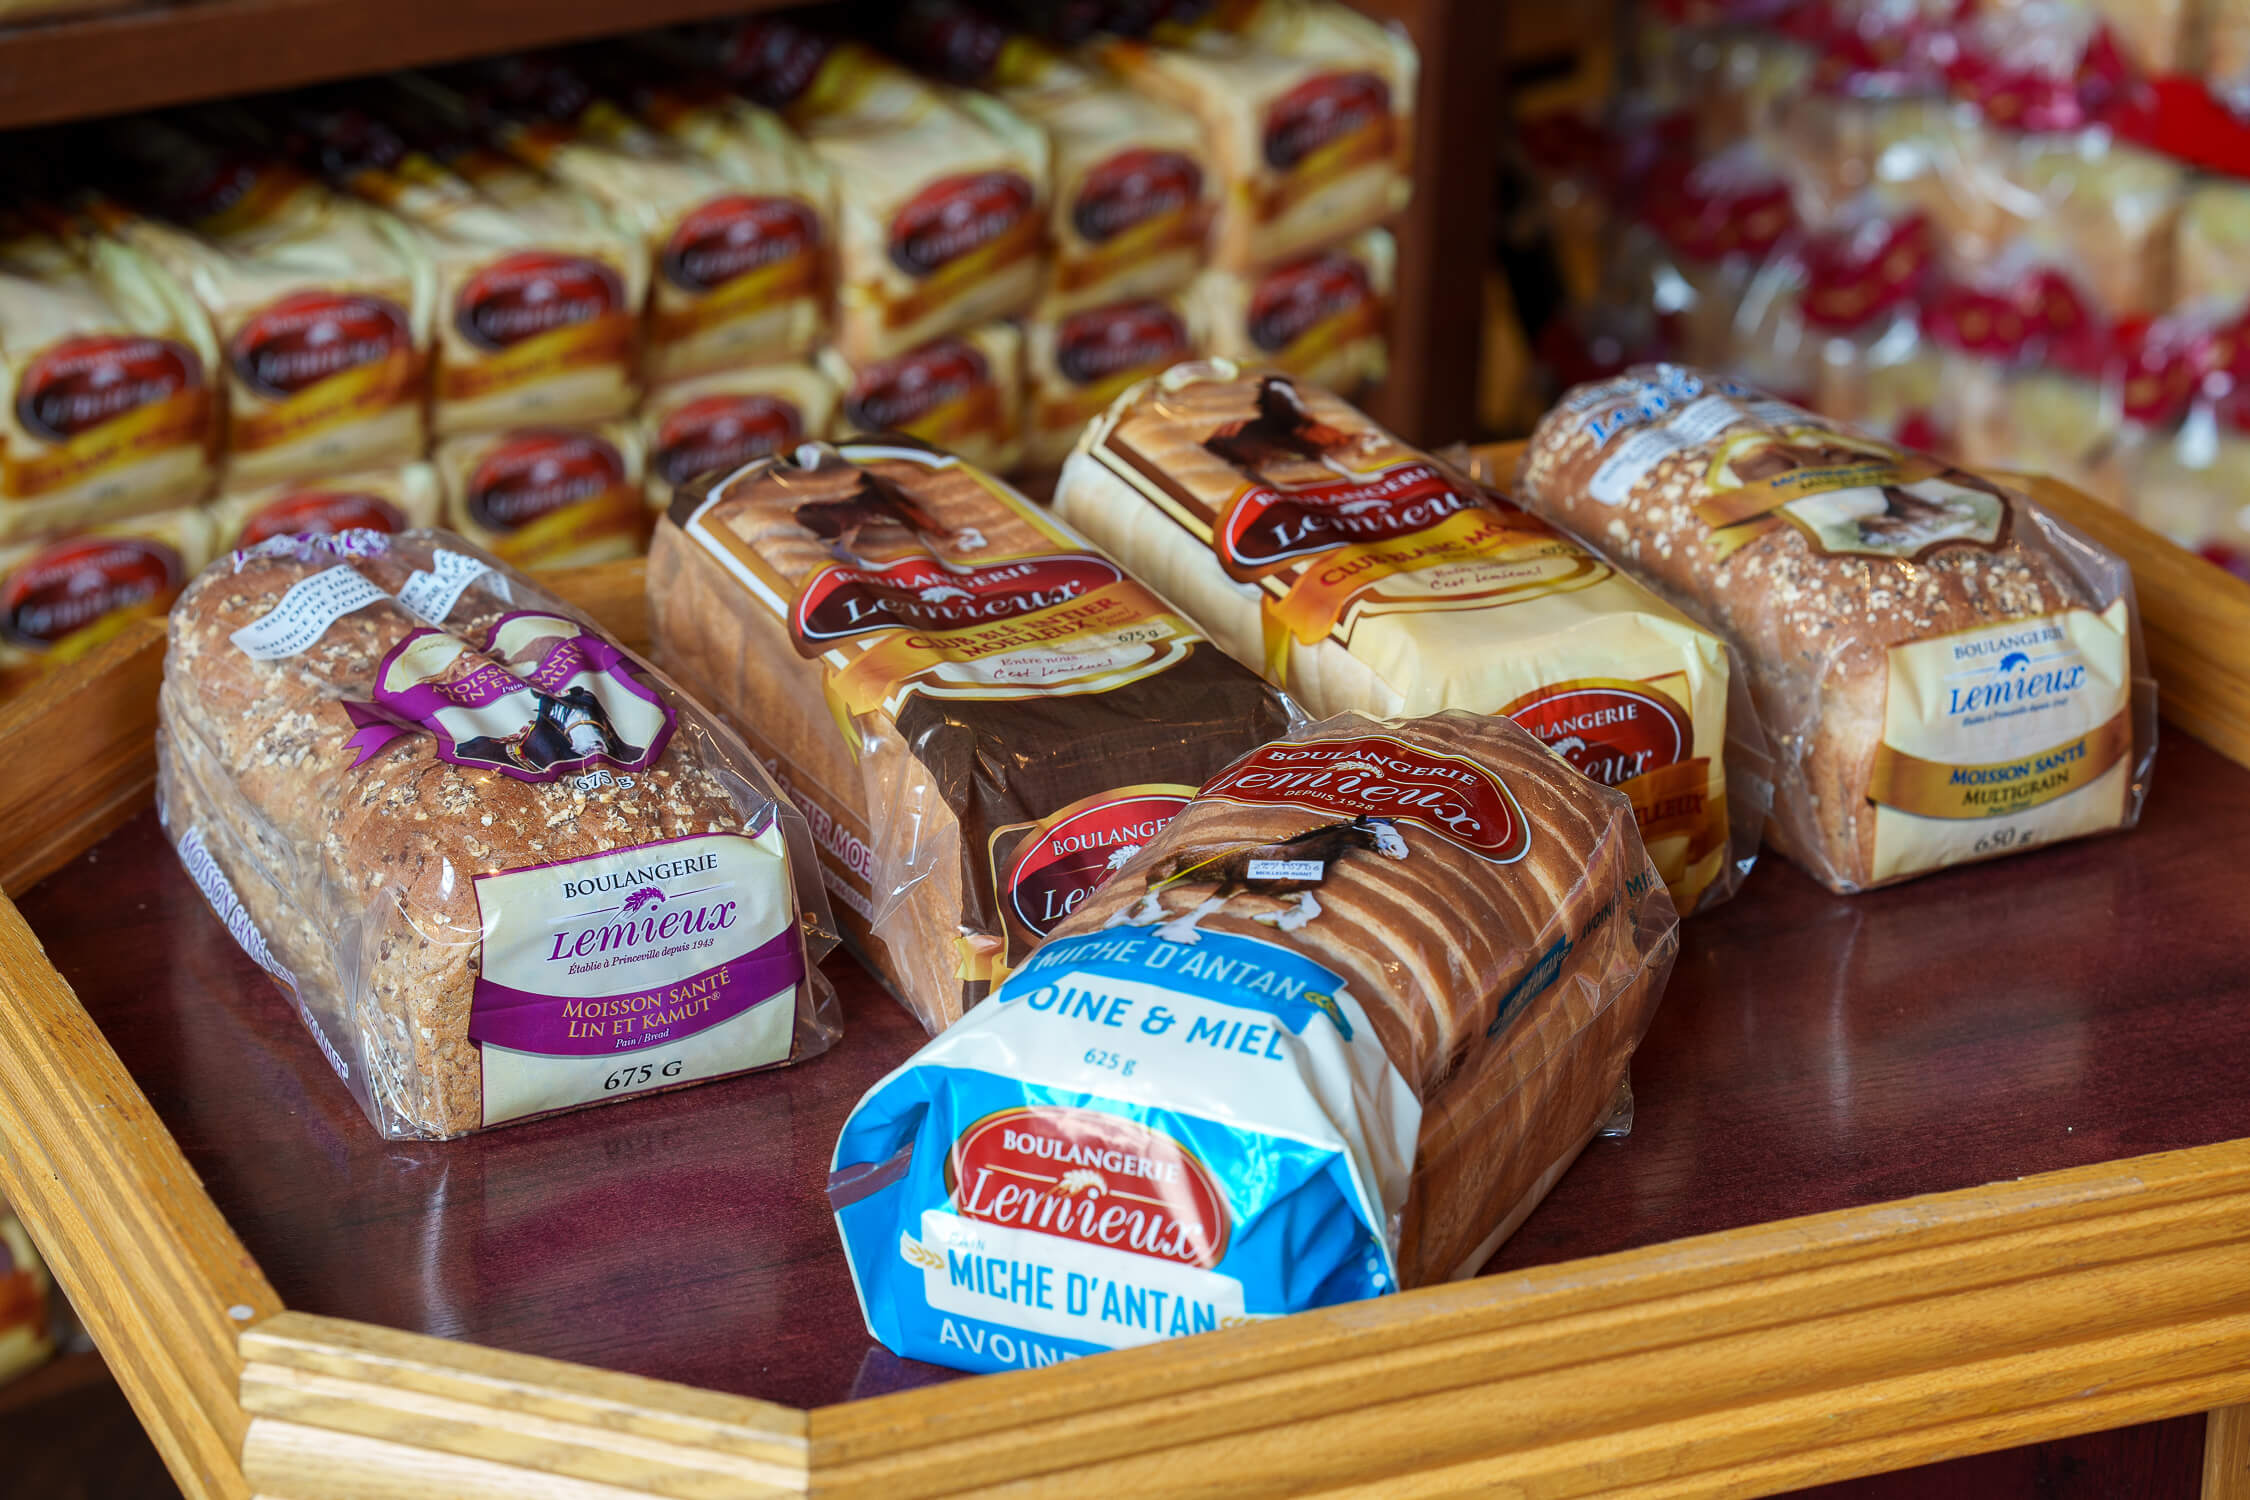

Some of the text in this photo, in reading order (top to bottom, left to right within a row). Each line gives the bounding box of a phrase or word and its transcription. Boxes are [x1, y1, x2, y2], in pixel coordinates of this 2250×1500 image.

[843, 580, 1087, 625] Lemieux
[432, 667, 503, 695] MOISS
[1948, 664, 2087, 716] Lemieux
[1528, 703, 1639, 738] ULANGERIE
[575, 770, 615, 792] 675
[1267, 750, 1478, 787] BOULANGERIE
[1949, 762, 2031, 786] MOISSON
[1962, 768, 2070, 807] MULTIGRAIN
[1284, 789, 1376, 812] DEPUIS 1928
[562, 852, 718, 899] BOULANGERIE
[1041, 885, 1097, 922] Le
[546, 900, 738, 962] Lemieux
[567, 937, 715, 976] Établie à Princeville depuis 1943
[1033, 939, 1307, 1002] MICHE D'ANTAN
[561, 966, 732, 1019] MOISSON SANTÉ
[567, 1020, 607, 1039] LIN
[611, 1017, 637, 1037] ET
[614, 1037, 637, 1049] Pain
[643, 1027, 671, 1044] Bread
[1027, 984, 1284, 1062] OINE & MIEL
[603, 1059, 684, 1091] 675 G
[1083, 1048, 1138, 1078] 625 g
[1002, 1129, 1181, 1186] BOULANGERIE
[963, 1167, 1205, 1260] Lemieux
[947, 1248, 1217, 1337] MICHE D'ANTAN
[939, 1318, 1084, 1370] AVOIN
